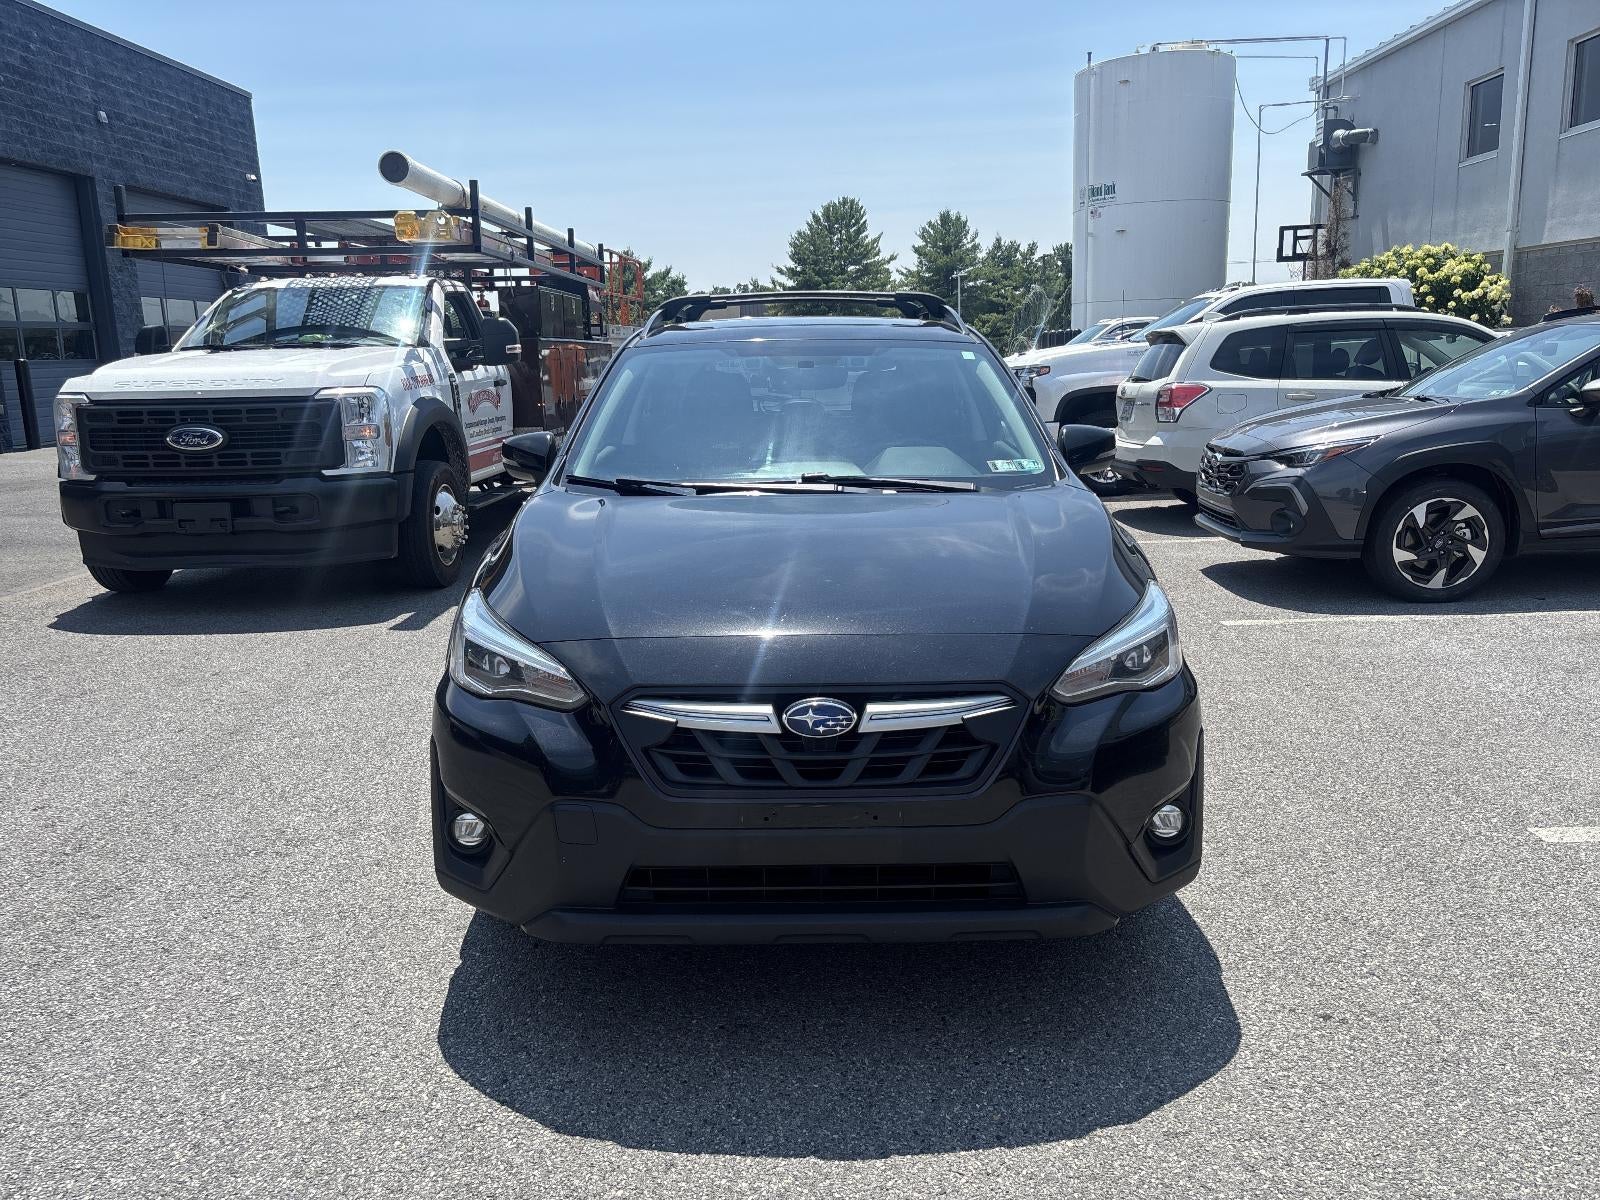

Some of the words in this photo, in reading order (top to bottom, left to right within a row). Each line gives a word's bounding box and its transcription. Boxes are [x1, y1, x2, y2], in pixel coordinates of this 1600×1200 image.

[113, 379, 203, 389] SUPER
[210, 377, 284, 387] DUTY
[177, 433, 210, 446] Ford
